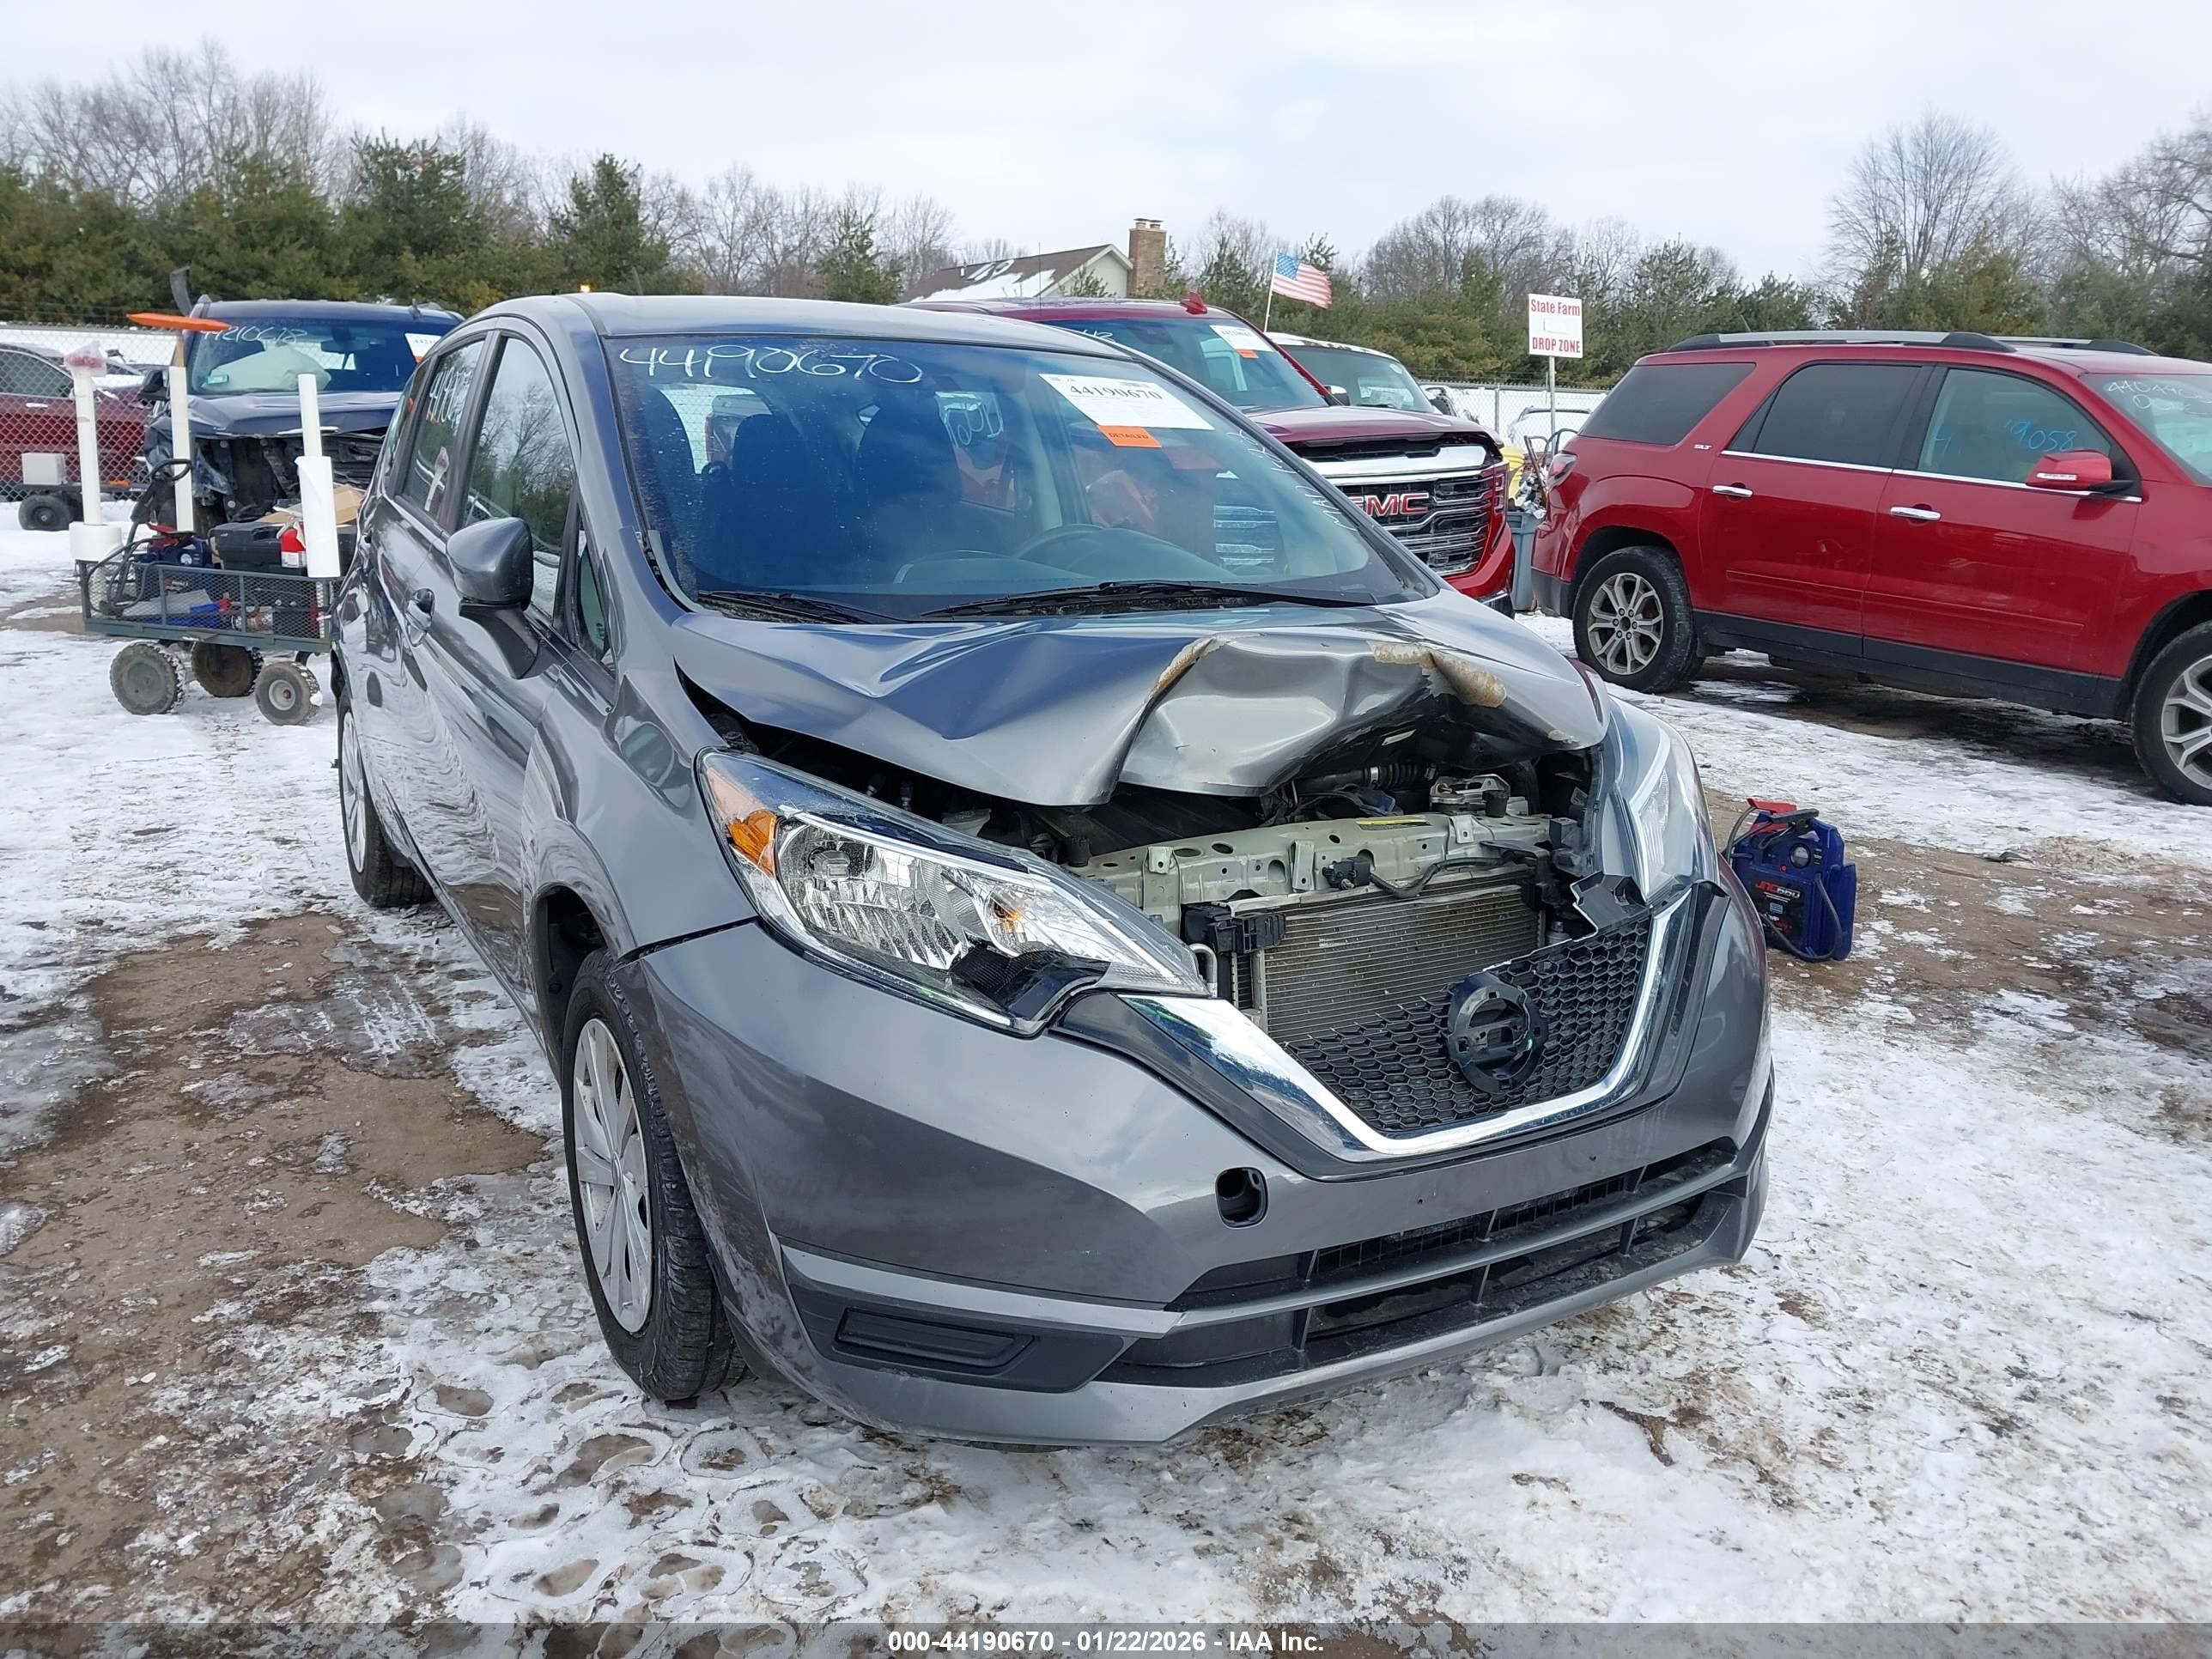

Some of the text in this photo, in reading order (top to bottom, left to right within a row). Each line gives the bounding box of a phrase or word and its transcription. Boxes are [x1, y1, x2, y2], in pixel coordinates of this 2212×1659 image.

[1531, 299, 1580, 317] State Farm
[1532, 337, 1581, 354] DROP ZONE
[619, 344, 923, 383] 44190670
[1070, 385, 1164, 400] 44190670
[1108, 432, 1151, 441] DETAILED
